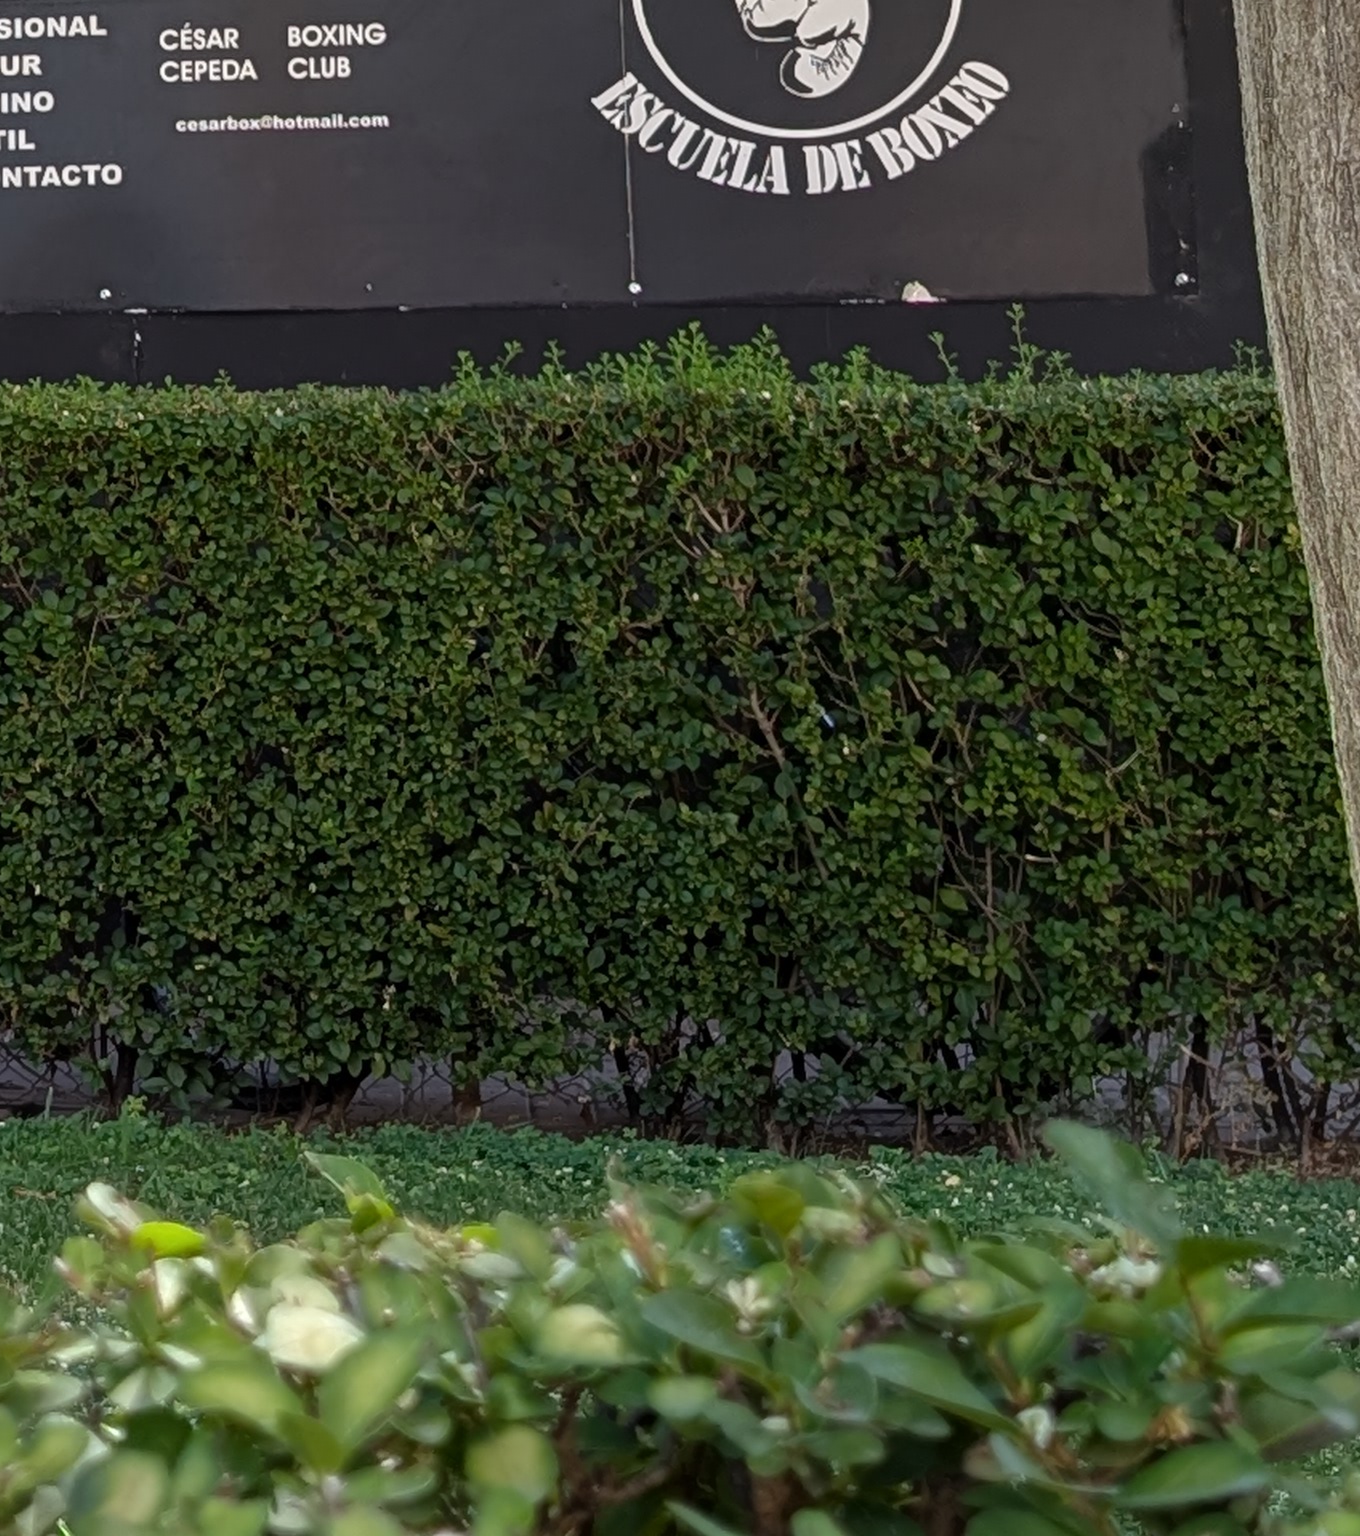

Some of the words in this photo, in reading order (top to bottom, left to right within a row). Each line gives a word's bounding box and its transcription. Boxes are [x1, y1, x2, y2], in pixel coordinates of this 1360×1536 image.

[159, 22, 239, 52] CÉSAR
[287, 22, 387, 47] BOXING
[159, 58, 259, 83] CEPEDA
[287, 56, 351, 80] CLUB
[175, 113, 390, 133] cesarbox@hotmail.com
[590, 71, 790, 195] ESCUELA
[802, 139, 872, 195] DE
[865, 60, 1011, 181] BOXEO
